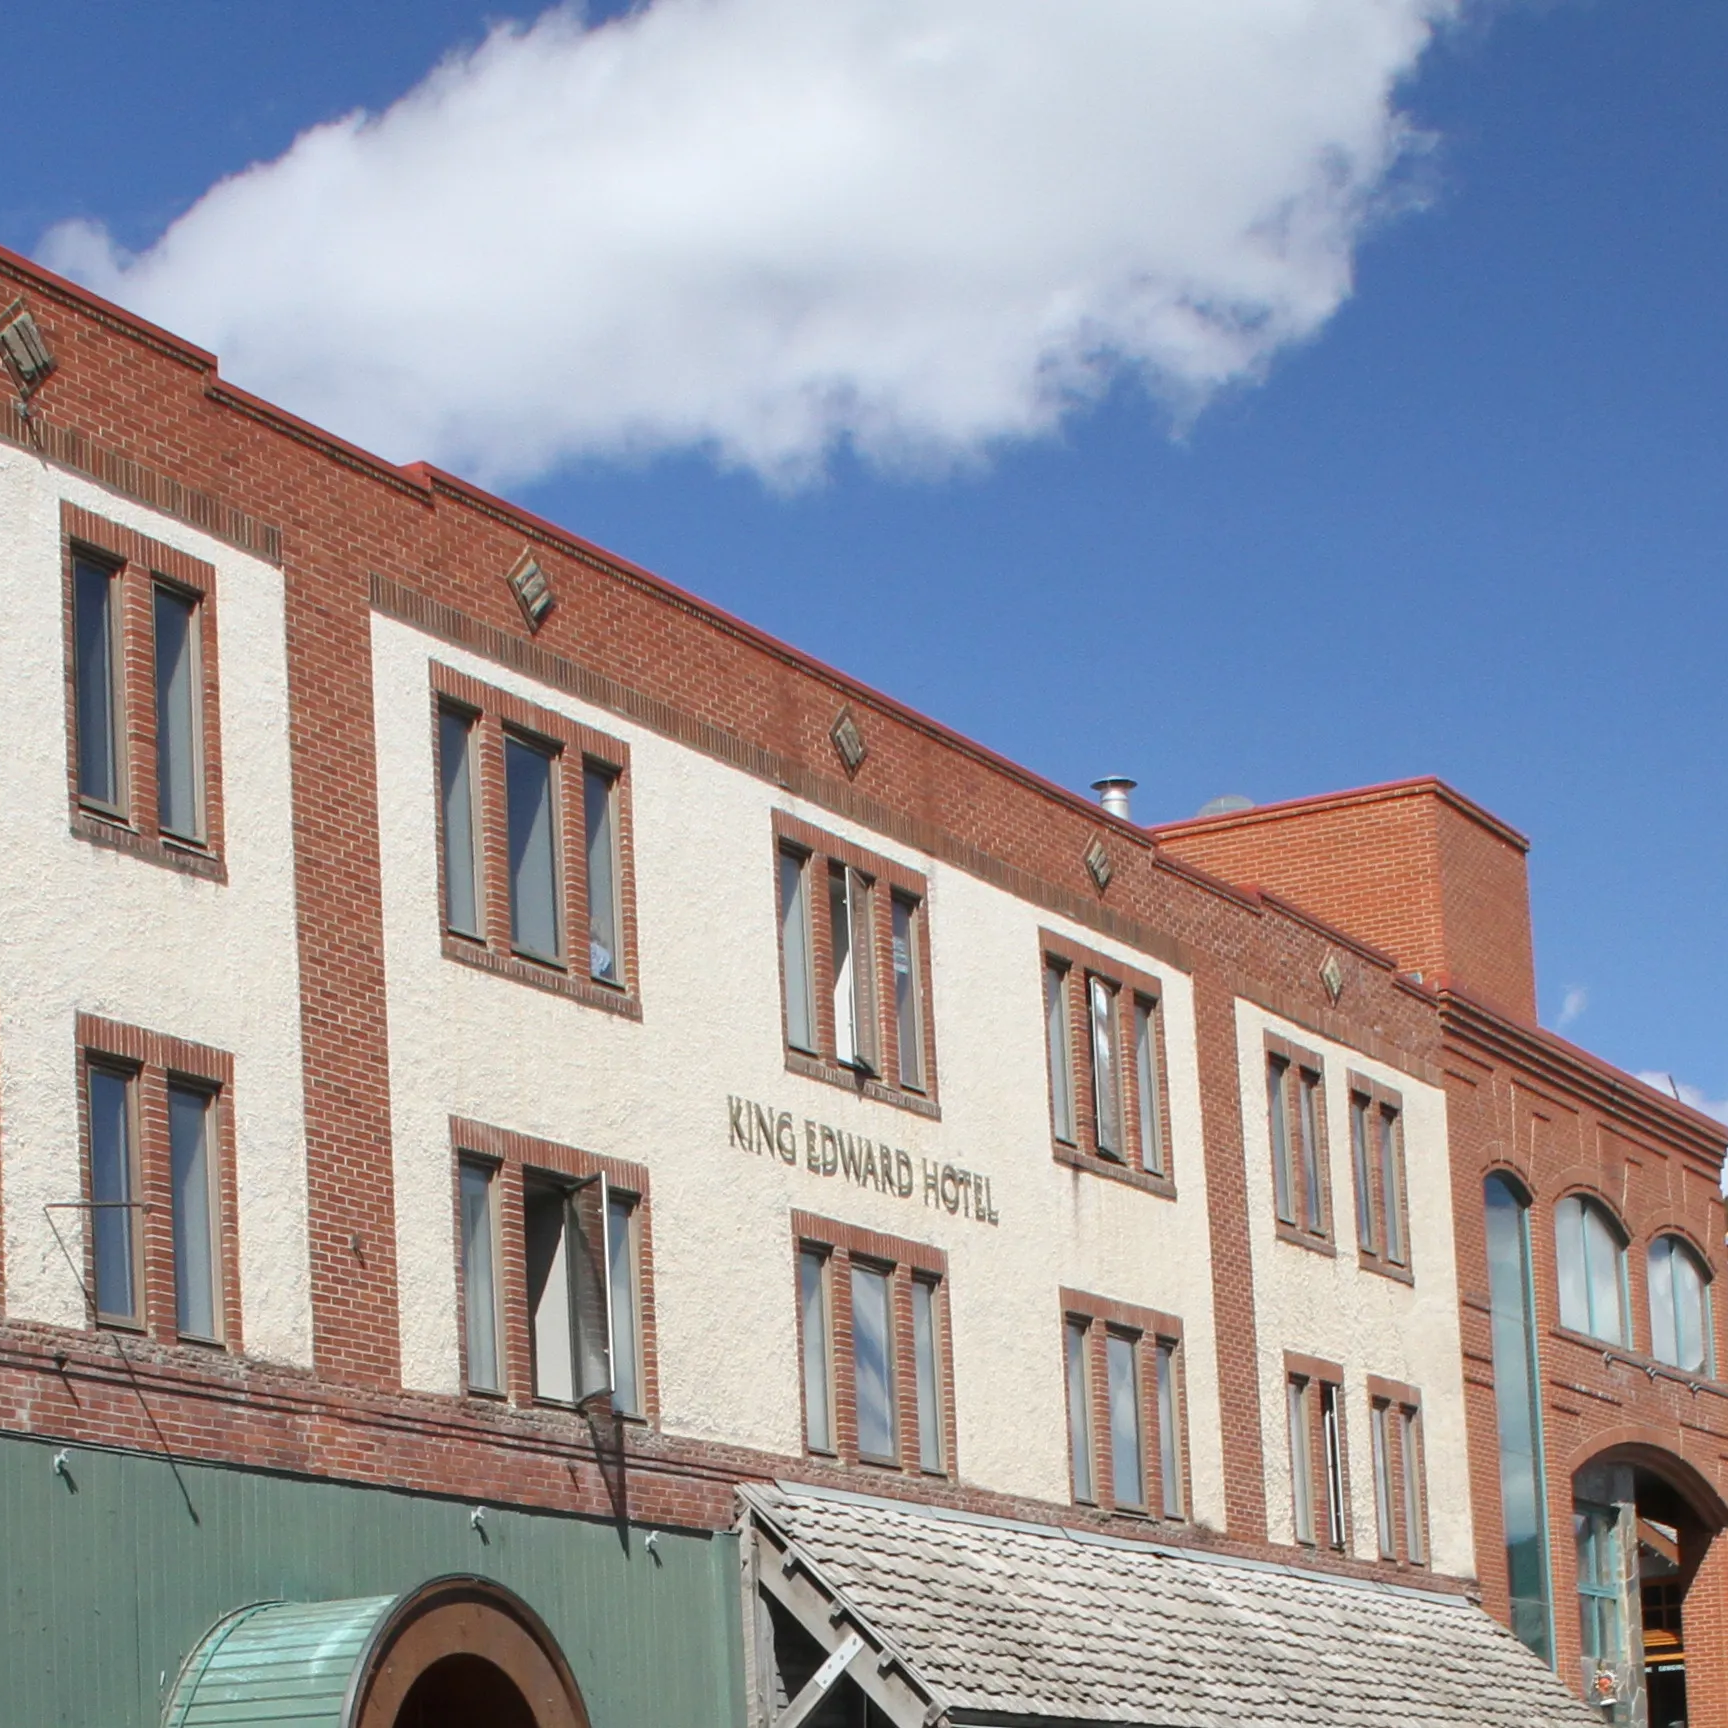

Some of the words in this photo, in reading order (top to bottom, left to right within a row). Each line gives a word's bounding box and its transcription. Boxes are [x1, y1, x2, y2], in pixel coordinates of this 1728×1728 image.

[727, 1094, 796, 1166] KING
[804, 1118, 914, 1199] EDWARD
[922, 1157, 999, 1226] HOTEL
